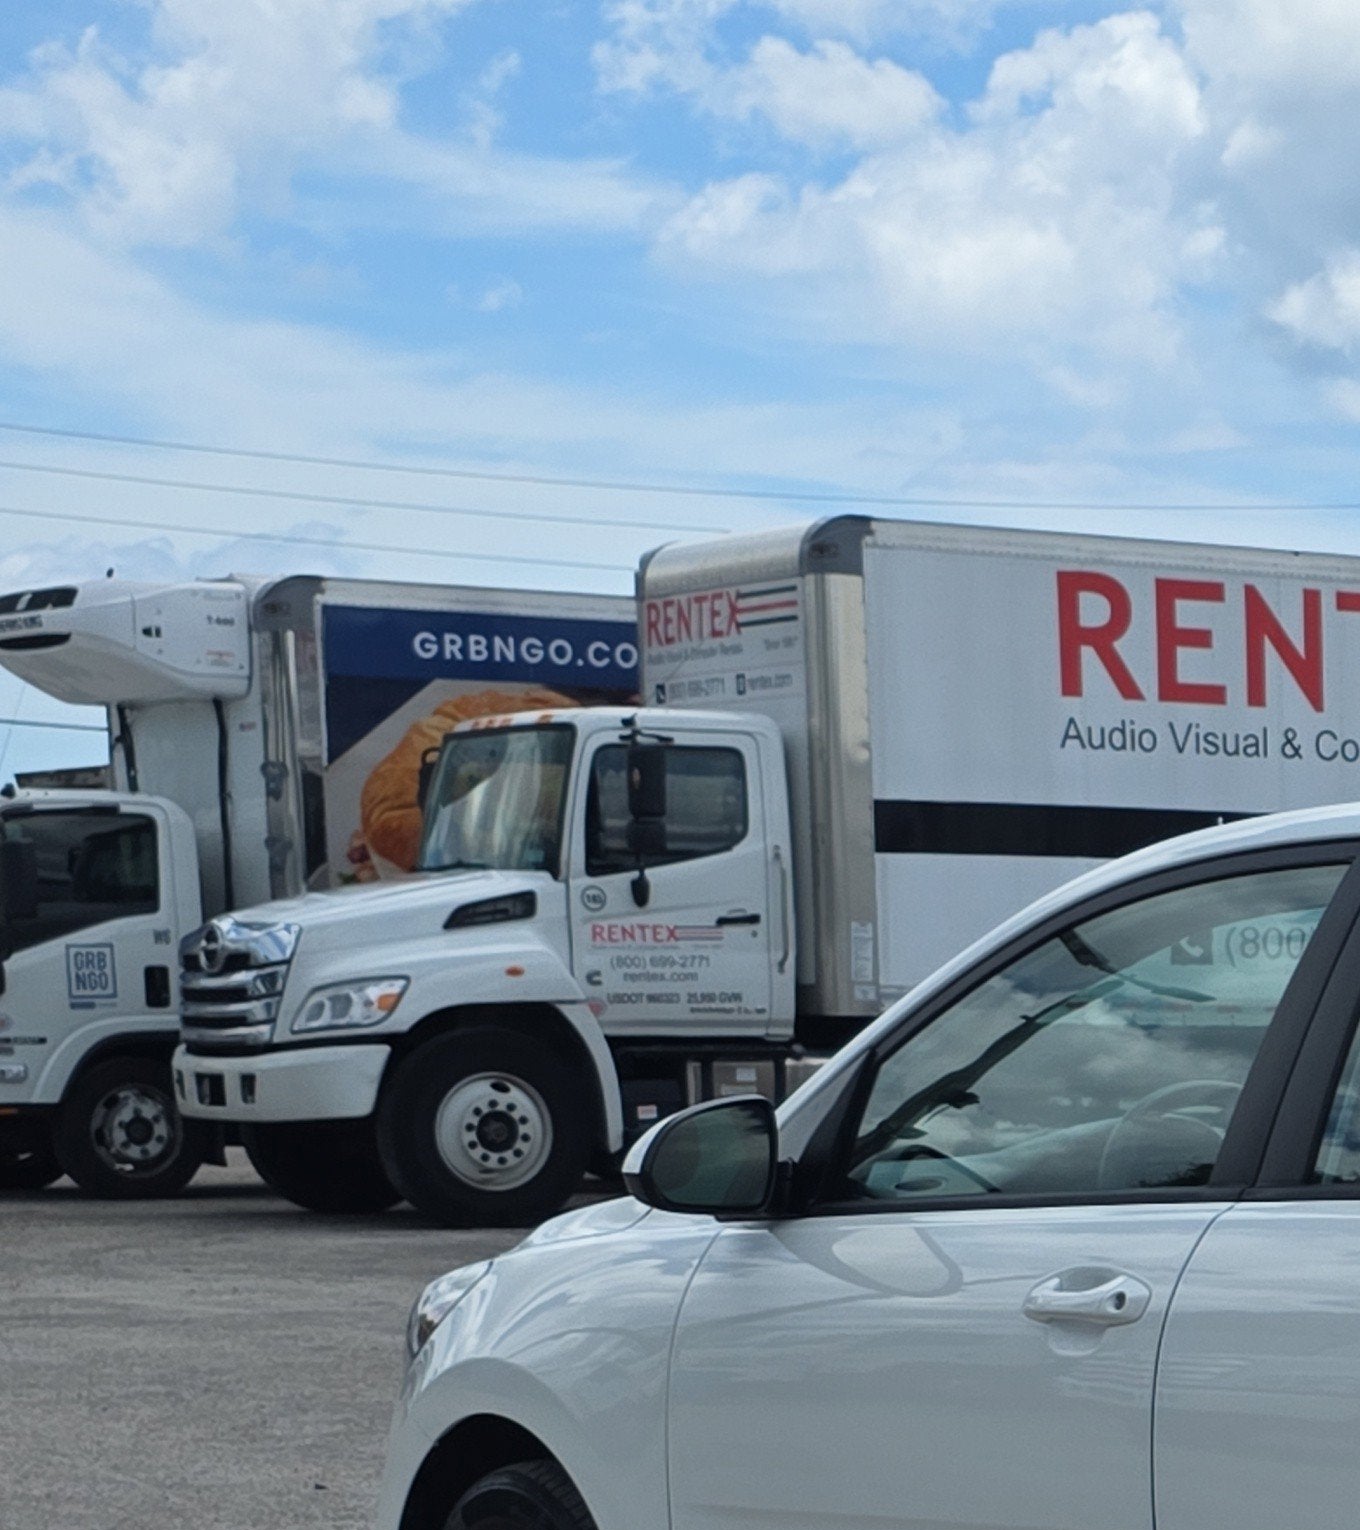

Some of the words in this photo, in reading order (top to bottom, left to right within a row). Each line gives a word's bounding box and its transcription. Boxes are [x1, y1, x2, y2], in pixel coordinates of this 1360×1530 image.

[646, 589, 742, 647] RENTEX
[1060, 717, 1157, 754] Audio
[1168, 721, 1269, 759] Visual
[1280, 728, 1303, 760] &
[591, 923, 679, 942] RENTEX
[73, 951, 107, 971] GRB
[610, 954, 647, 970] (800)
[75, 972, 109, 991] NGO
[623, 971, 699, 983] rentex.com
